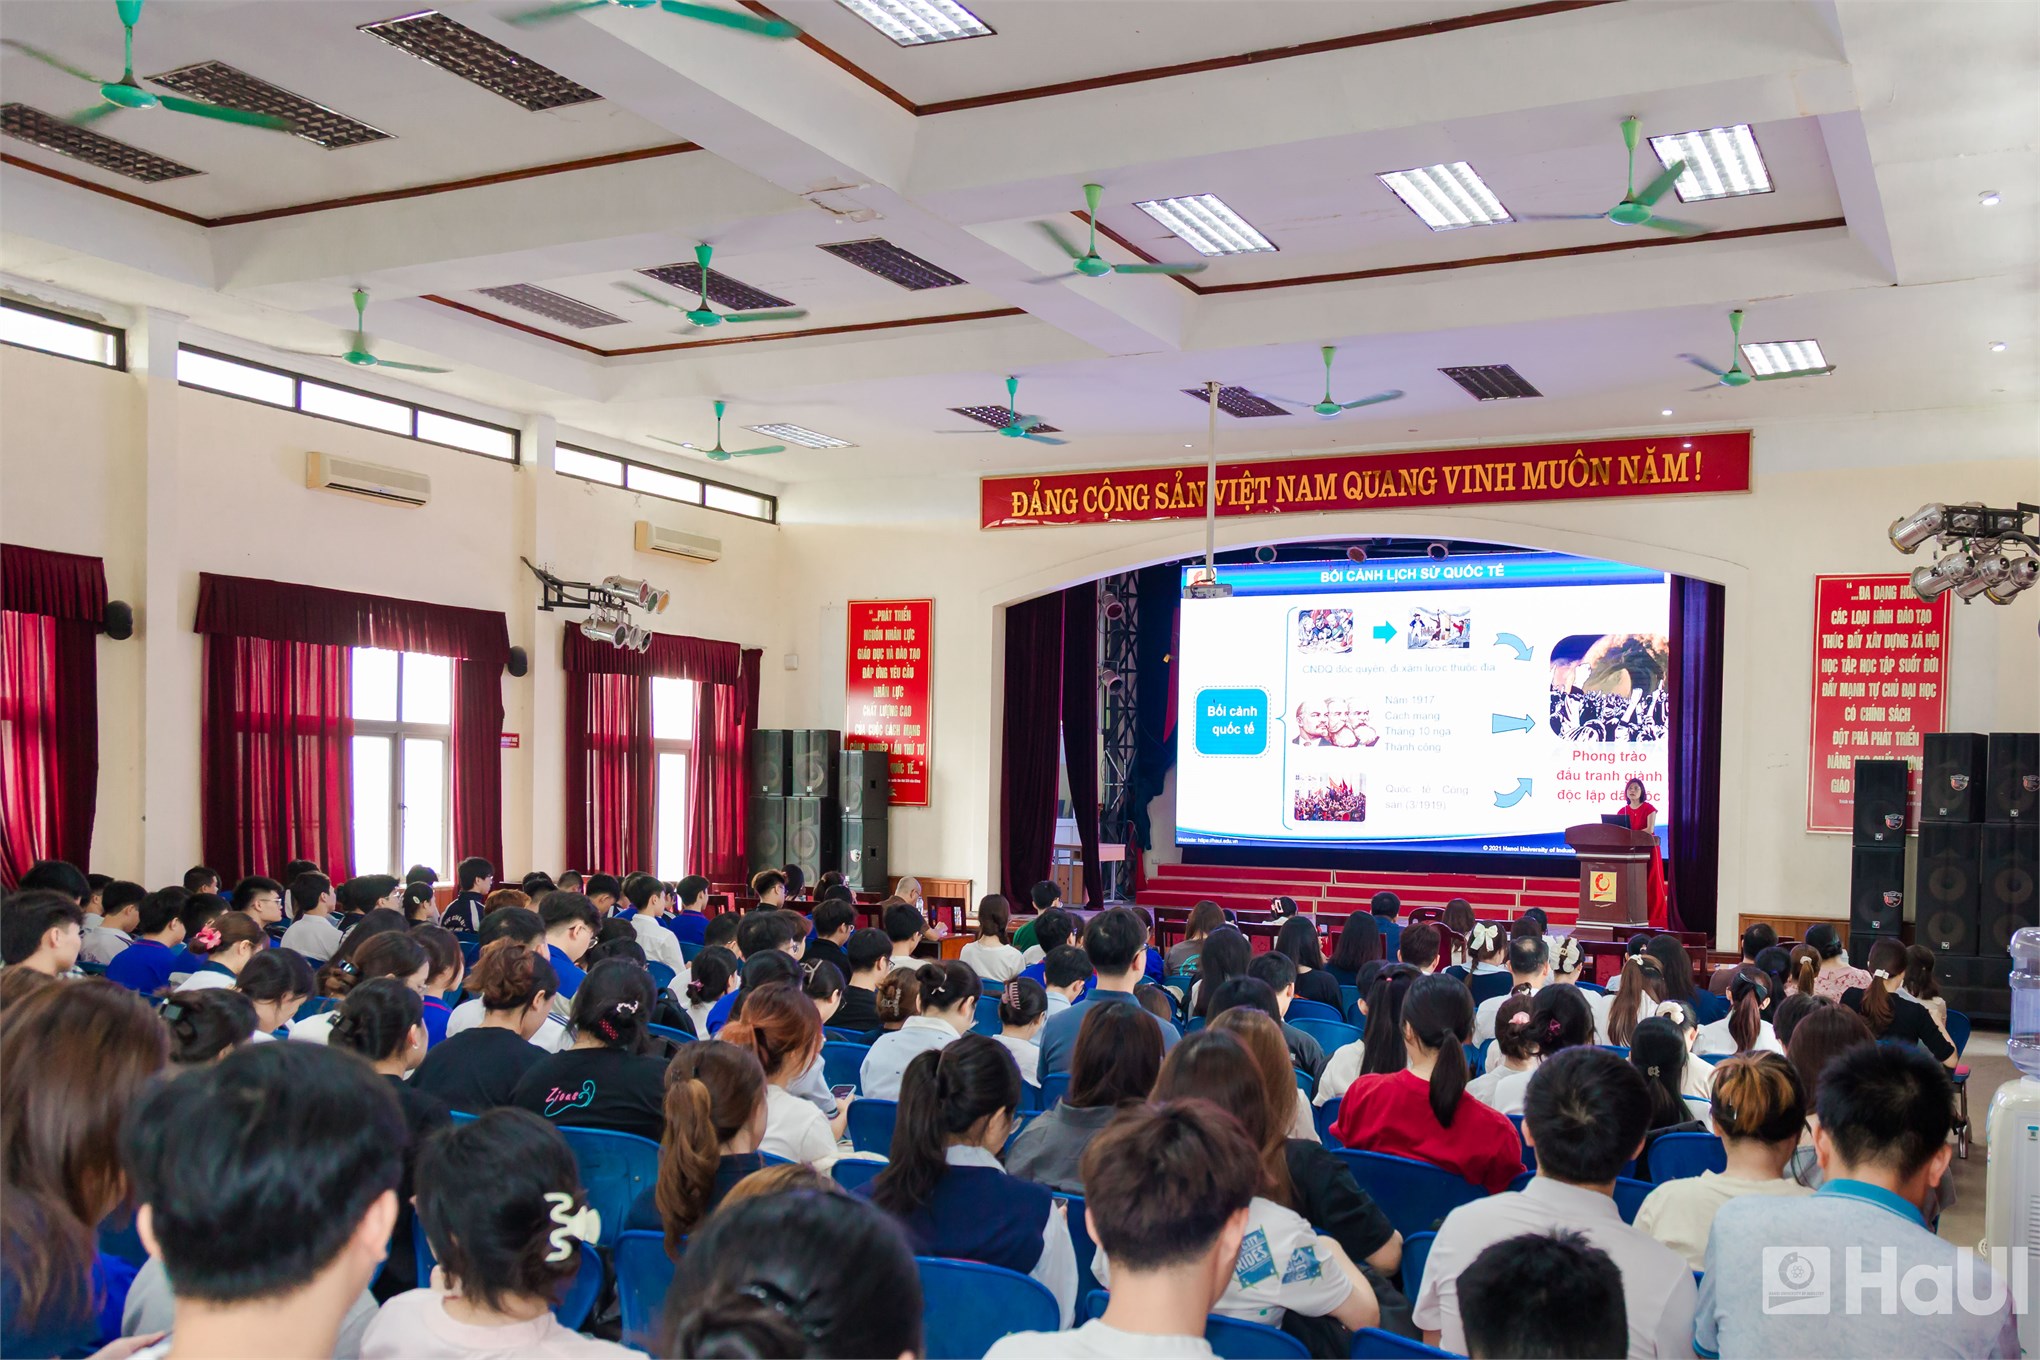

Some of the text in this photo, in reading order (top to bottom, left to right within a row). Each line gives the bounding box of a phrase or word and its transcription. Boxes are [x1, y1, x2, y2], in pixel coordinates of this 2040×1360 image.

[1011, 446, 1702, 519] ĐẢNG CỘNG SẢN VIỆT NAM QUANG VINH MUÔN NĂM !
[1320, 563, 1505, 583] BỐI CẢNH LỊCH SỬ QUỐC TẾ
[1873, 585, 1897, 603] DẠNG
[1831, 606, 1932, 627] CÁC LOẠI HÌNH ĐÀO TẠO
[1822, 629, 1940, 651] THÚC ĐẨY XÂY DỰNG XÃ HỘI
[1821, 658, 1838, 675] HỌC
[1860, 658, 1877, 676] HỌC
[1880, 655, 1895, 675] TẬP
[1898, 653, 1921, 673] SUỐT
[1923, 654, 1939, 673] ĐỜI
[1822, 677, 1937, 700] ĐẨY MẠNH TỰ CHỦ ĐẠI HỌC
[1412, 695, 1435, 704] 1917
[1207, 704, 1258, 717] Bối cảnh
[1844, 703, 1911, 722] CÓ CHÍNH SÁCH
[1212, 721, 1255, 737] quốc tế
[1419, 726, 1430, 736] 10
[1832, 725, 1920, 748] ĐỘT PHÁ PHÁT TRIỂN
[1573, 750, 1647, 764] Phong trào
[1827, 751, 1851, 770] NÂNG
[1556, 767, 1662, 784] đấu tranh giành
[1831, 776, 1850, 794] GIÁO
[1557, 789, 1581, 803] độc
[1586, 789, 1606, 804] lập
[1610, 790, 1627, 801] dâ
[1520, 846, 1548, 854] University
